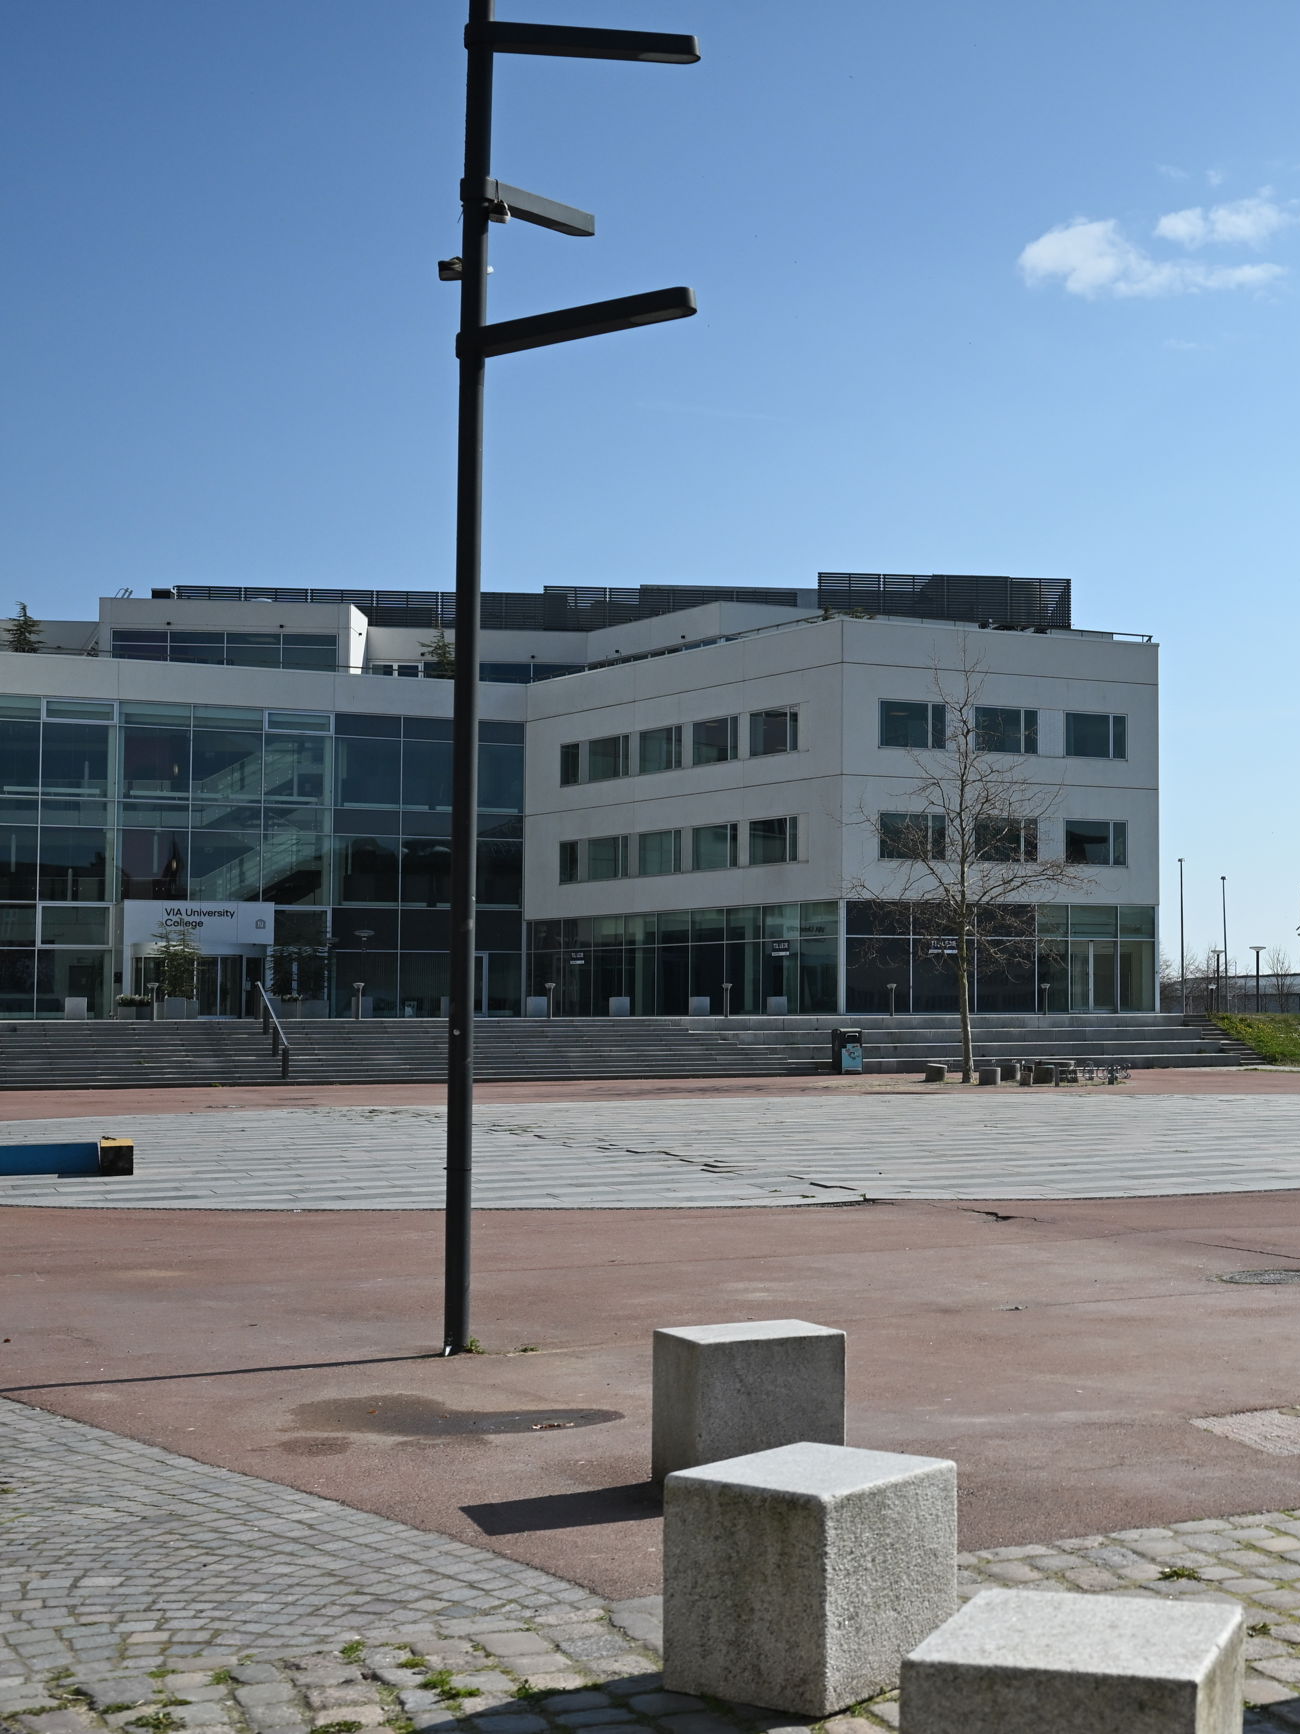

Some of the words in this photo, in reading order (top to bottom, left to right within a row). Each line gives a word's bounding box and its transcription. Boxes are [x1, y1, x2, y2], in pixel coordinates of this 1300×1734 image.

[165, 908, 182, 917] VIA
[186, 908, 235, 919] University
[165, 918, 204, 930] College
